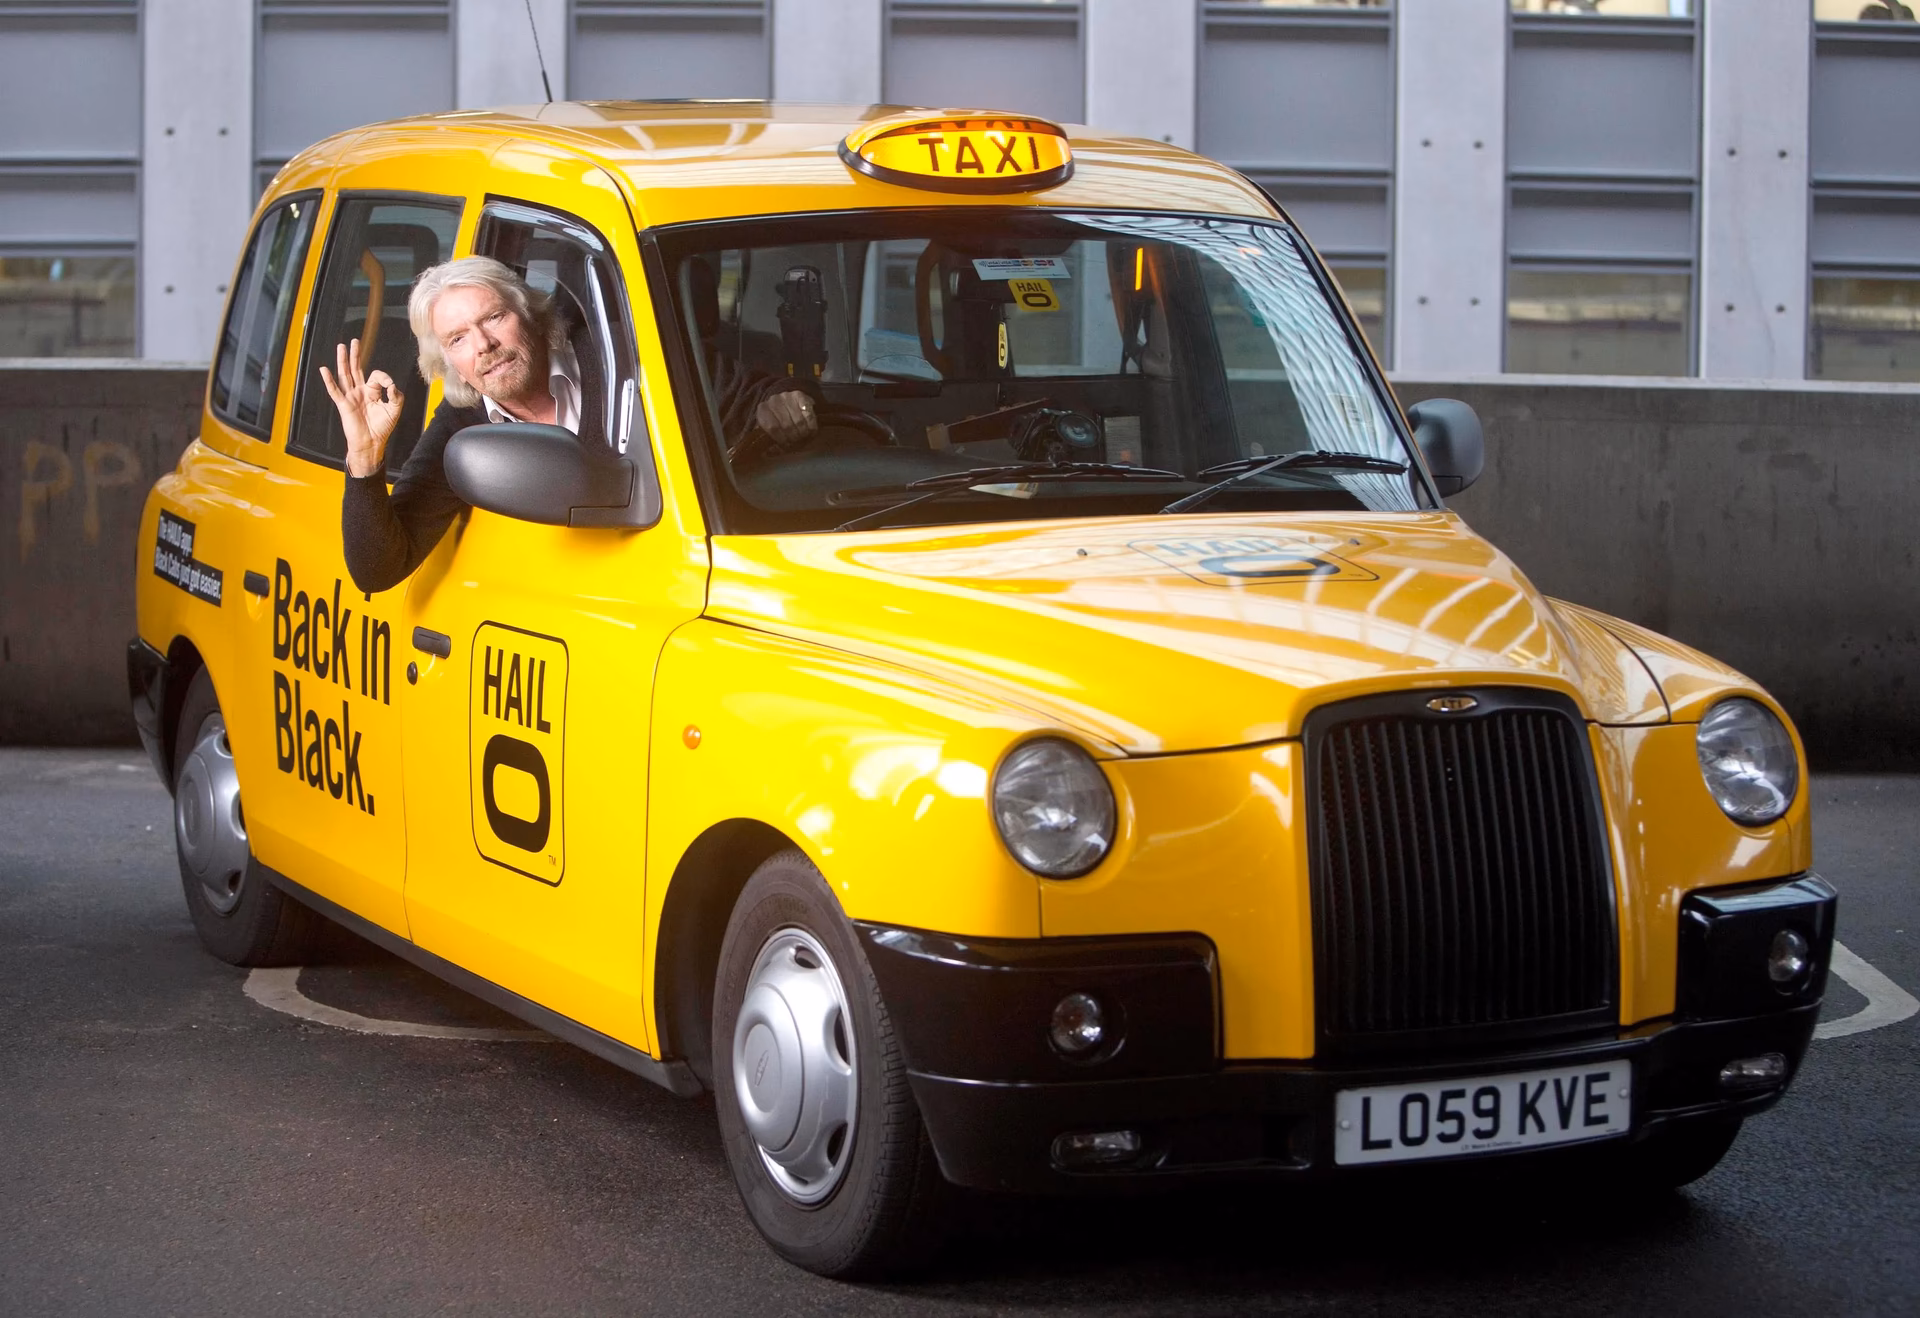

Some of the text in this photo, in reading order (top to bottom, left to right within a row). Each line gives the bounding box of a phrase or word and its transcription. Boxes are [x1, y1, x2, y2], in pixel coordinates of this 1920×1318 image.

[918, 135, 1040, 175] TAXI
[1016, 282, 1047, 292] HAIL
[200, 572, 221, 600] easier.
[1157, 539, 1289, 556] HAIL
[273, 557, 391, 706] Back in
[483, 645, 551, 734] HAIL
[273, 669, 375, 817] Black.
[482, 733, 551, 853] O
[1361, 1071, 1611, 1151] LO59 KVE
